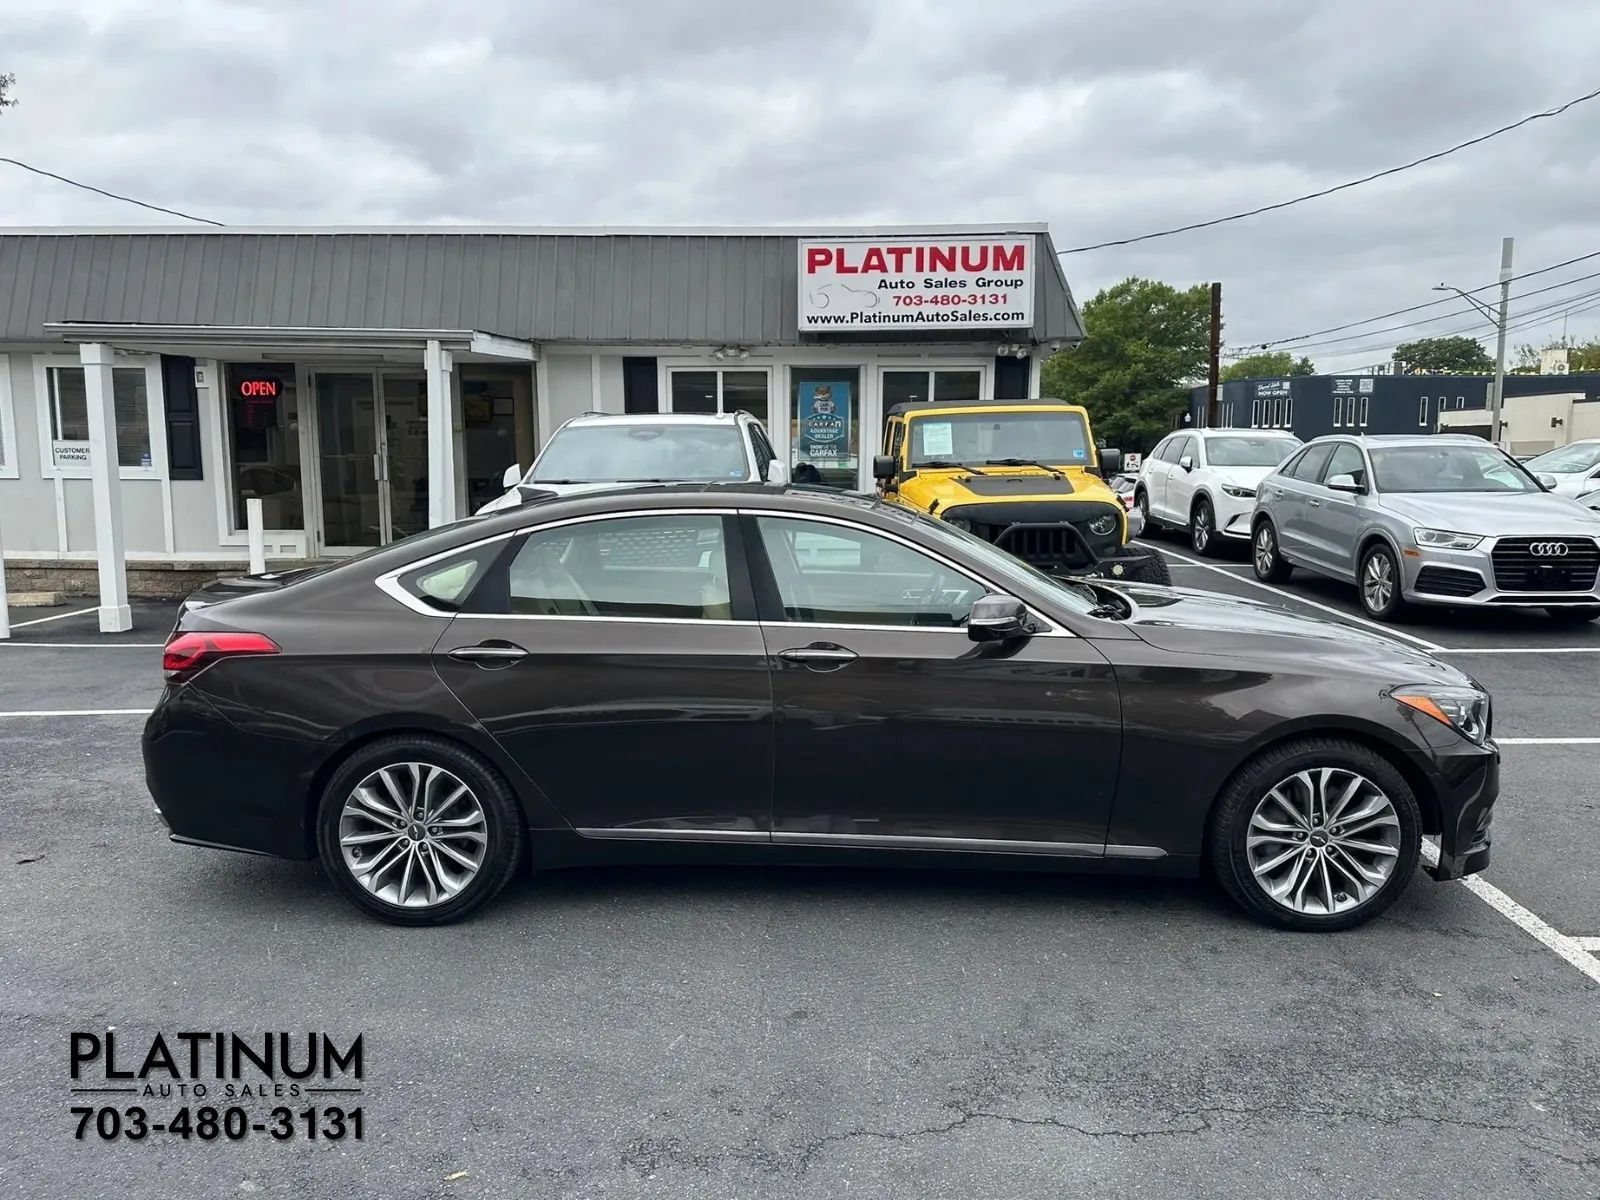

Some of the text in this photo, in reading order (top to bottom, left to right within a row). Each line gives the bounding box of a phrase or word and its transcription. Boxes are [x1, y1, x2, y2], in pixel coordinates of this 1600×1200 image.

[807, 245, 1025, 274] PLATINUM
[877, 277, 1024, 290] Auto Sales Group
[892, 294, 1008, 306] 703-480-3131
[806, 310, 1025, 324] www.PlatinumAutoSales.com
[241, 381, 276, 396] OPEN
[810, 449, 838, 457] CARFAX
